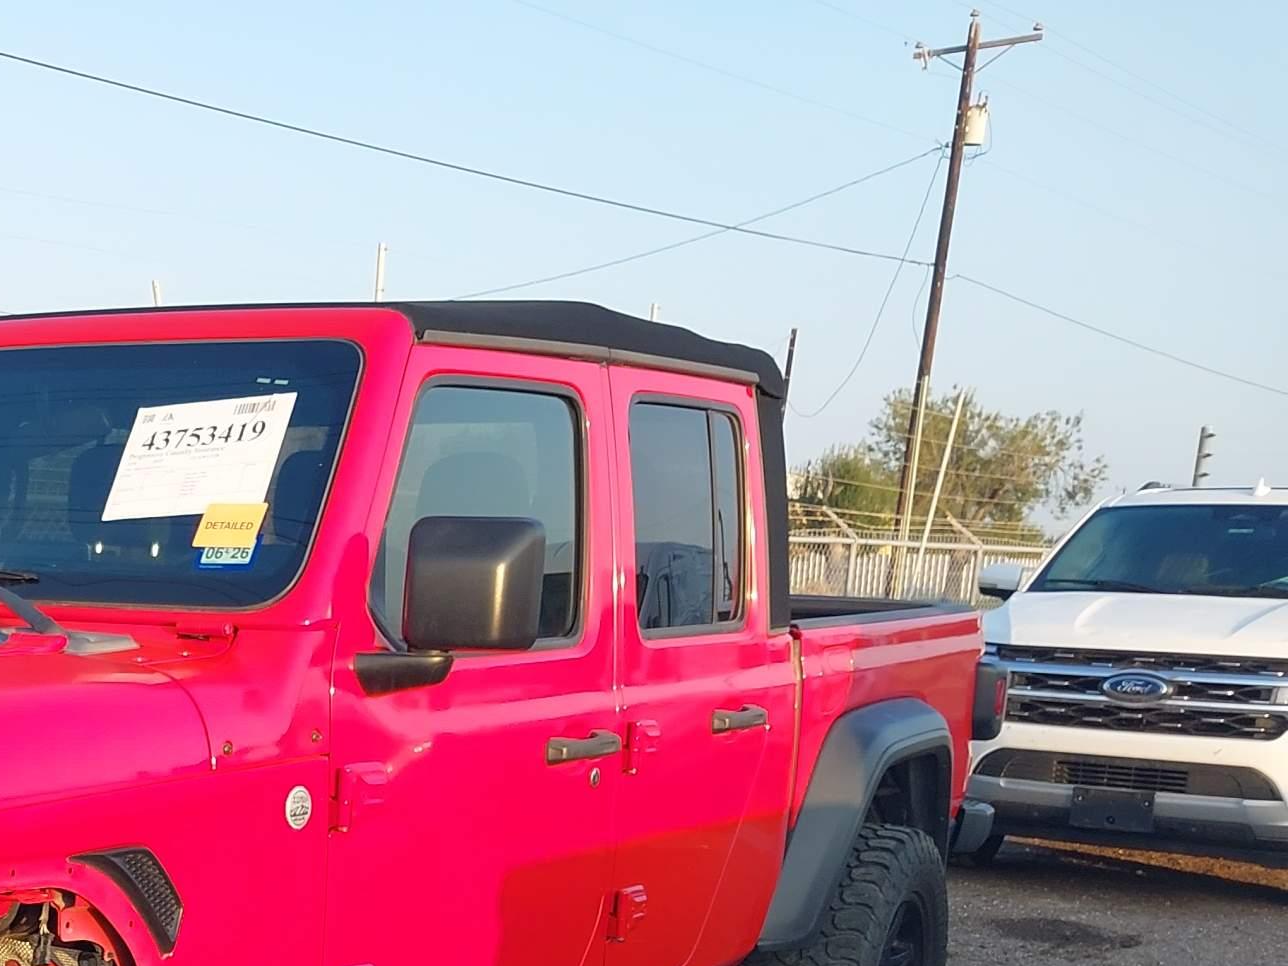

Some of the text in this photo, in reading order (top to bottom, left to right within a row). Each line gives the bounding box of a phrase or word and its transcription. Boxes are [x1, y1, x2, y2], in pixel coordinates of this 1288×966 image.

[142, 420, 266, 450] 43753419
[204, 521, 254, 531] DETAILED
[230, 547, 249, 559] 26
[1116, 680, 1153, 695] Ford
